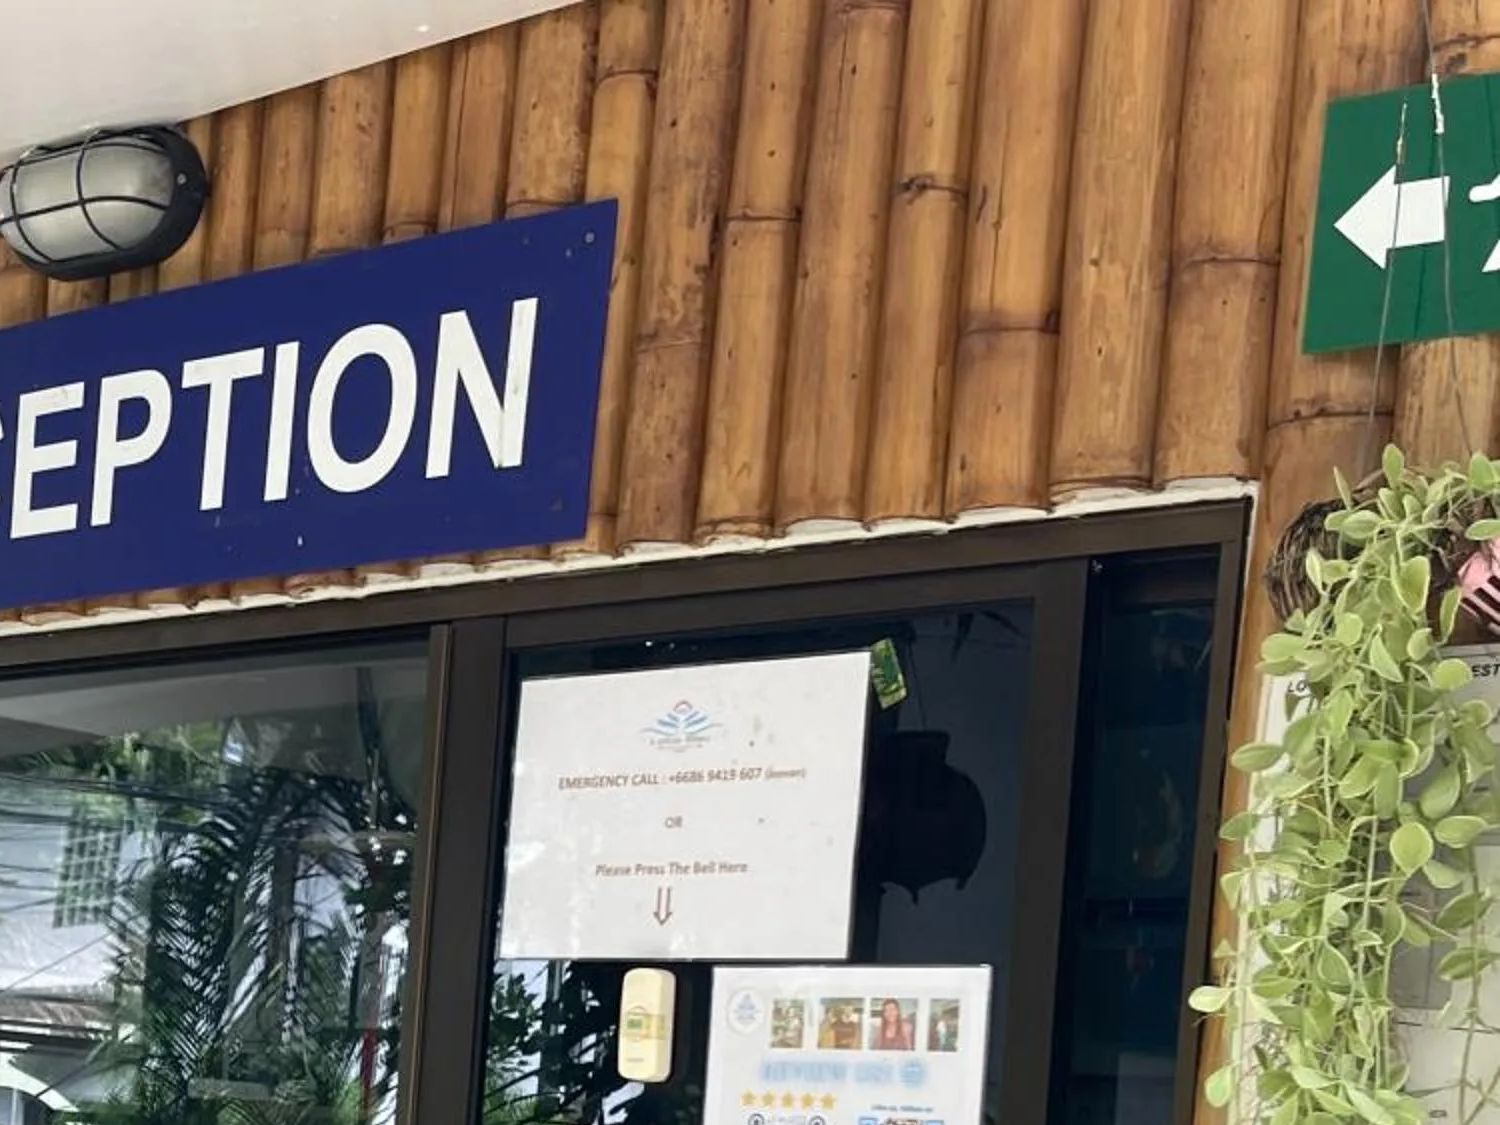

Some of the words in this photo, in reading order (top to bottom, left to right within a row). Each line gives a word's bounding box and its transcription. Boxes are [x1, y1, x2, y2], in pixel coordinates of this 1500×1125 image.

[558, 772, 628, 791] EMERGENCY
[631, 771, 660, 787] CALL
[739, 767, 763, 781] 607
[664, 815, 683, 830] OR
[595, 863, 632, 877] Please
[635, 863, 666, 877] Press
[669, 862, 690, 876] The
[693, 861, 717, 875] Bell
[719, 861, 748, 874] Here
